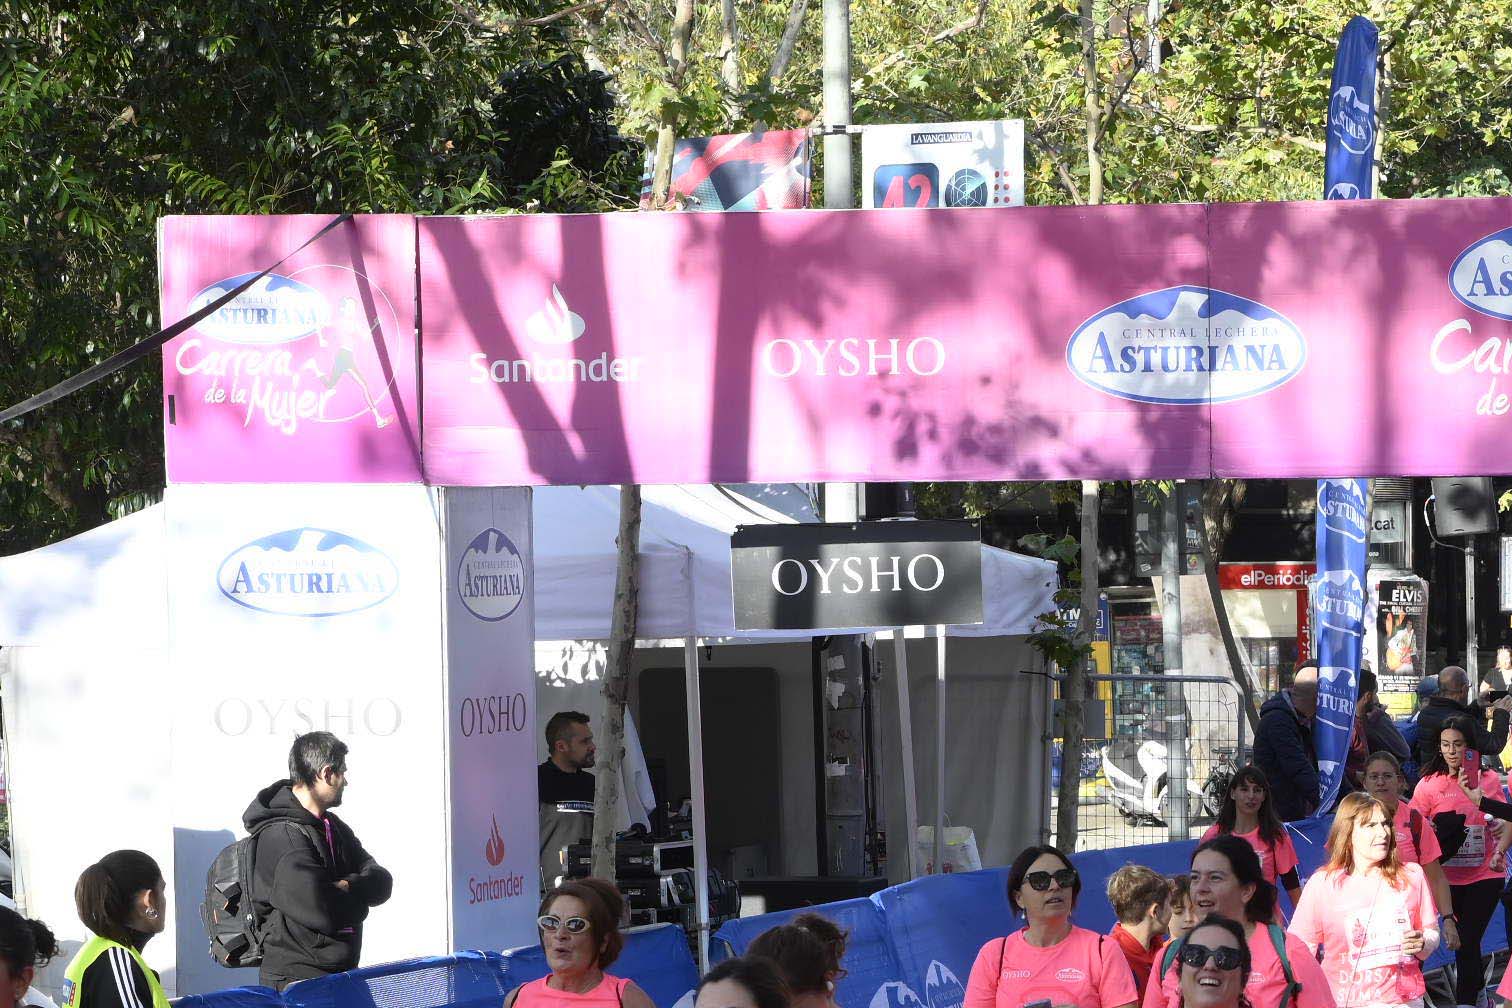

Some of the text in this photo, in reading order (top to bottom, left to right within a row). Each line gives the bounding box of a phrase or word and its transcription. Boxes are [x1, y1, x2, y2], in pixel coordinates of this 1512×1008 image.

[1086, 331, 1289, 374] ASTURIANA
[1122, 328, 1201, 340] CENTRAL
[175, 338, 302, 376] Carrera
[470, 352, 648, 384] Santander
[763, 337, 946, 378] OYSHO
[205, 374, 336, 436] de la Mujer
[1475, 378, 1510, 416] de
[231, 561, 386, 594] ASTURIANA
[464, 563, 521, 598] ASTURIANA
[771, 554, 945, 597] OYSHO
[1392, 590, 1422, 602] ELVIS
[214, 698, 403, 736] OYSHO
[461, 693, 526, 737] OYSHO
[469, 872, 524, 904] Santander
